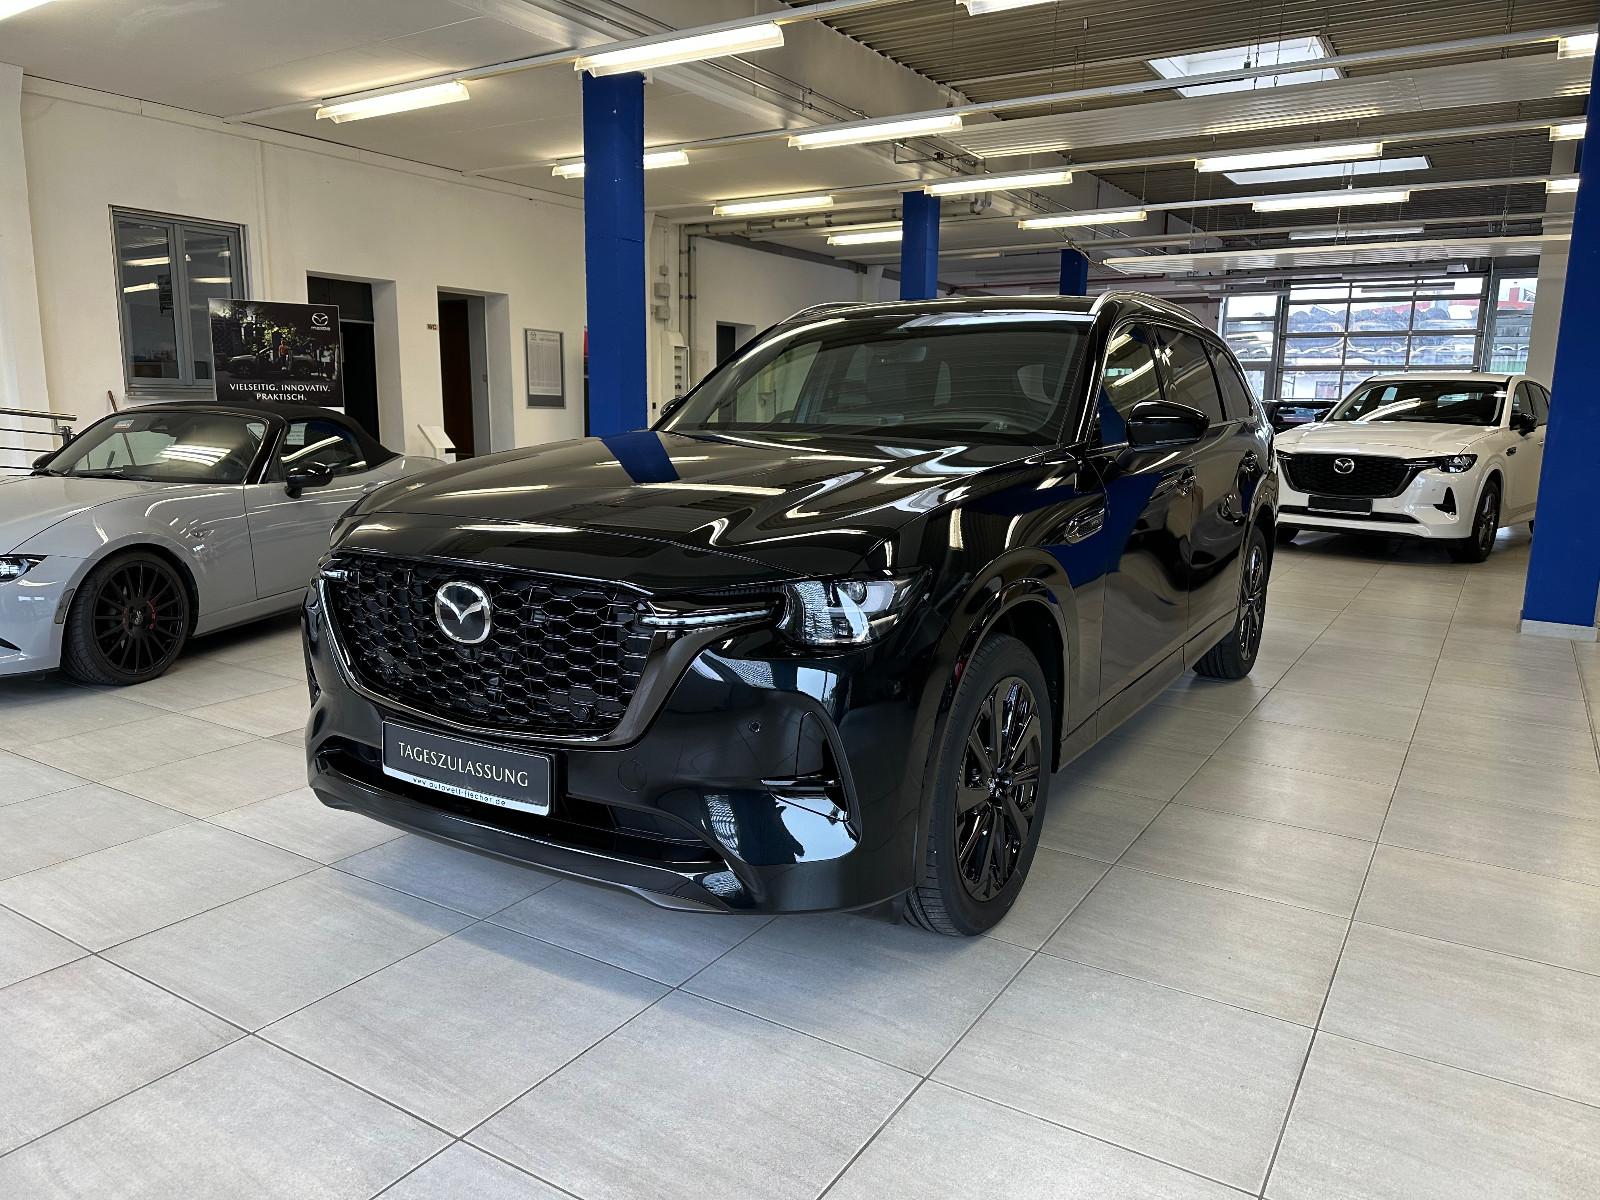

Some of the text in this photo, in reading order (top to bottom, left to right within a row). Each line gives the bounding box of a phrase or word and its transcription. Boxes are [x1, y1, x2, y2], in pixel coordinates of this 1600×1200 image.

[229, 383, 331, 392] VIELSEITIG. INNOVATIV.
[256, 393, 307, 401] PRAKTISCH.
[398, 741, 528, 787] TAGESZULASSUNG
